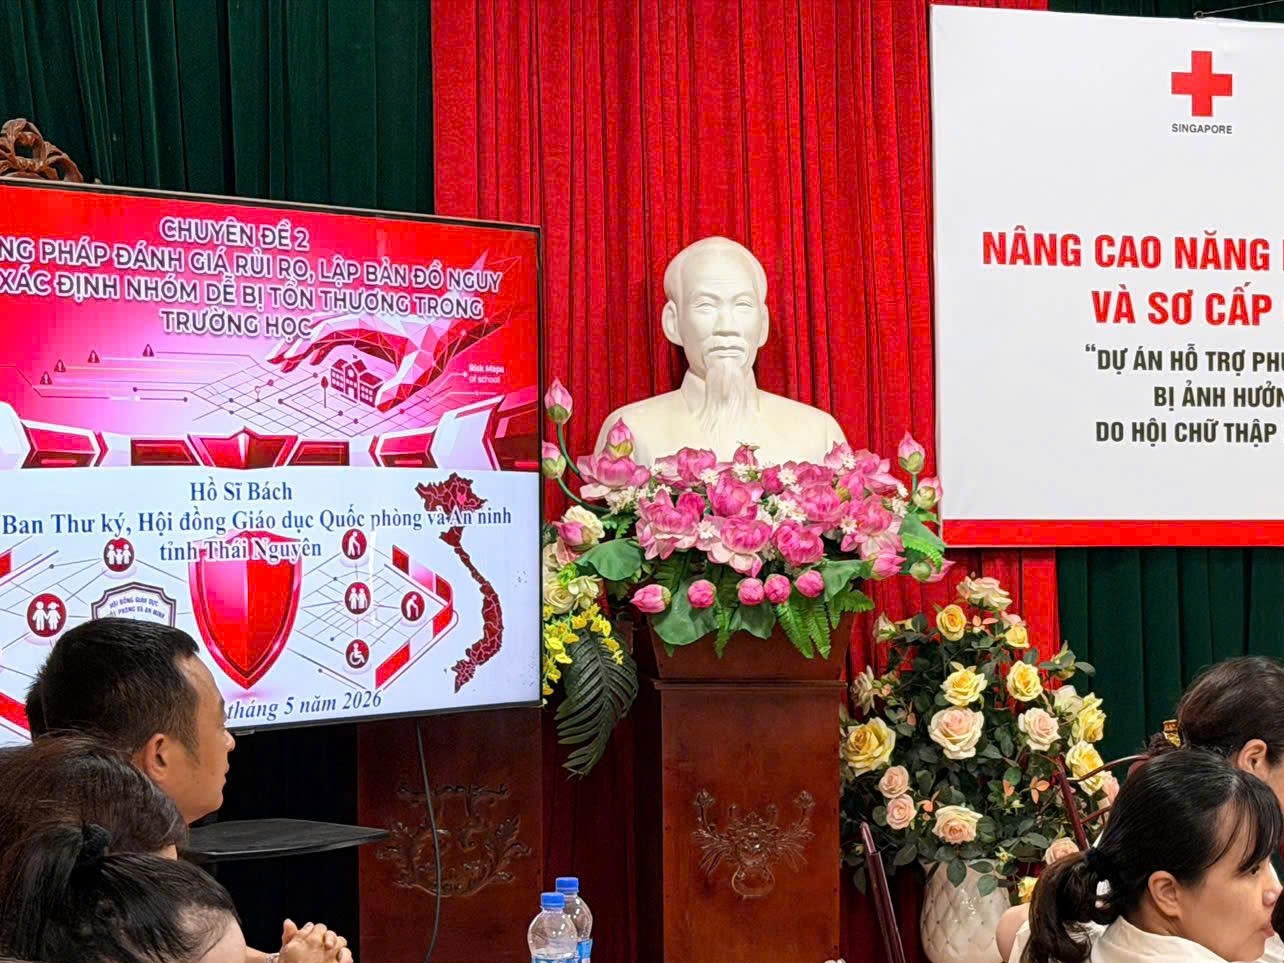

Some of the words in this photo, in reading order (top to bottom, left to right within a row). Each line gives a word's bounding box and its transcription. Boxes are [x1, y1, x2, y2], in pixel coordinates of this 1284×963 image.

[1171, 123, 1232, 134] SINGAPORE
[162, 217, 254, 245] CHUYÊN
[260, 218, 291, 248] ĐỀ
[294, 230, 309, 249] 2
[983, 225, 1081, 266] NÂNG
[1095, 235, 1161, 269] CAO
[1175, 231, 1269, 271] NĂNG
[41, 237, 107, 264] PHÁP
[116, 241, 183, 270] ĐÁNH
[191, 247, 229, 274] GIÁ
[235, 248, 272, 277] RỦI
[279, 259, 314, 283] RO,
[320, 257, 358, 287] LẬP
[366, 258, 408, 286] BẢN
[412, 260, 443, 286] ĐỒ
[448, 270, 501, 293] NGUY
[0, 264, 50, 295] XÁC
[57, 273, 118, 303] ĐỊNH
[127, 274, 198, 302] NHÓM
[206, 273, 235, 304] DỄ
[242, 284, 264, 310] BỊ
[320, 288, 409, 314] THƯƠNG
[415, 295, 483, 318] TRONG
[1092, 284, 1135, 323] VÀ
[1148, 290, 1193, 325] SƠ
[1206, 284, 1272, 326] CẤP
[161, 308, 258, 336] TRƯỜNG
[266, 316, 312, 341] HỌC
[1086, 344, 1128, 374] “DỰ
[1133, 346, 1162, 370] ÁN
[1171, 344, 1197, 371] HỖ
[1205, 350, 1245, 376] TRỢ
[1154, 387, 1174, 413] BỊ
[1182, 380, 1225, 407] ẢNH
[1096, 422, 1123, 442] DO
[1132, 418, 1166, 447] HỘI
[1175, 419, 1219, 442] CHỮ
[1224, 419, 1276, 447] THẬP
[190, 477, 217, 501] Hồ
[223, 482, 241, 501] Sĩ
[247, 482, 292, 500] Bách
[2, 514, 43, 535] Ban
[51, 512, 95, 533] Thư
[101, 512, 131, 537] ký,
[138, 512, 172, 536] Hội
[180, 506, 226, 535] đồng
[232, 510, 275, 530] Giáo
[282, 509, 313, 533] dục
[320, 504, 365, 532] Quốc
[370, 510, 422, 532] phòng
[428, 508, 447, 524] và
[450, 507, 472, 525] An
[478, 508, 512, 524] ninh
[160, 540, 197, 561] tỉnh
[204, 539, 248, 560] Thái
[254, 538, 321, 563] Nguyên
[227, 698, 278, 721] tháng
[284, 697, 294, 715] 5
[300, 695, 336, 713] năm
[342, 690, 382, 710] 2026
